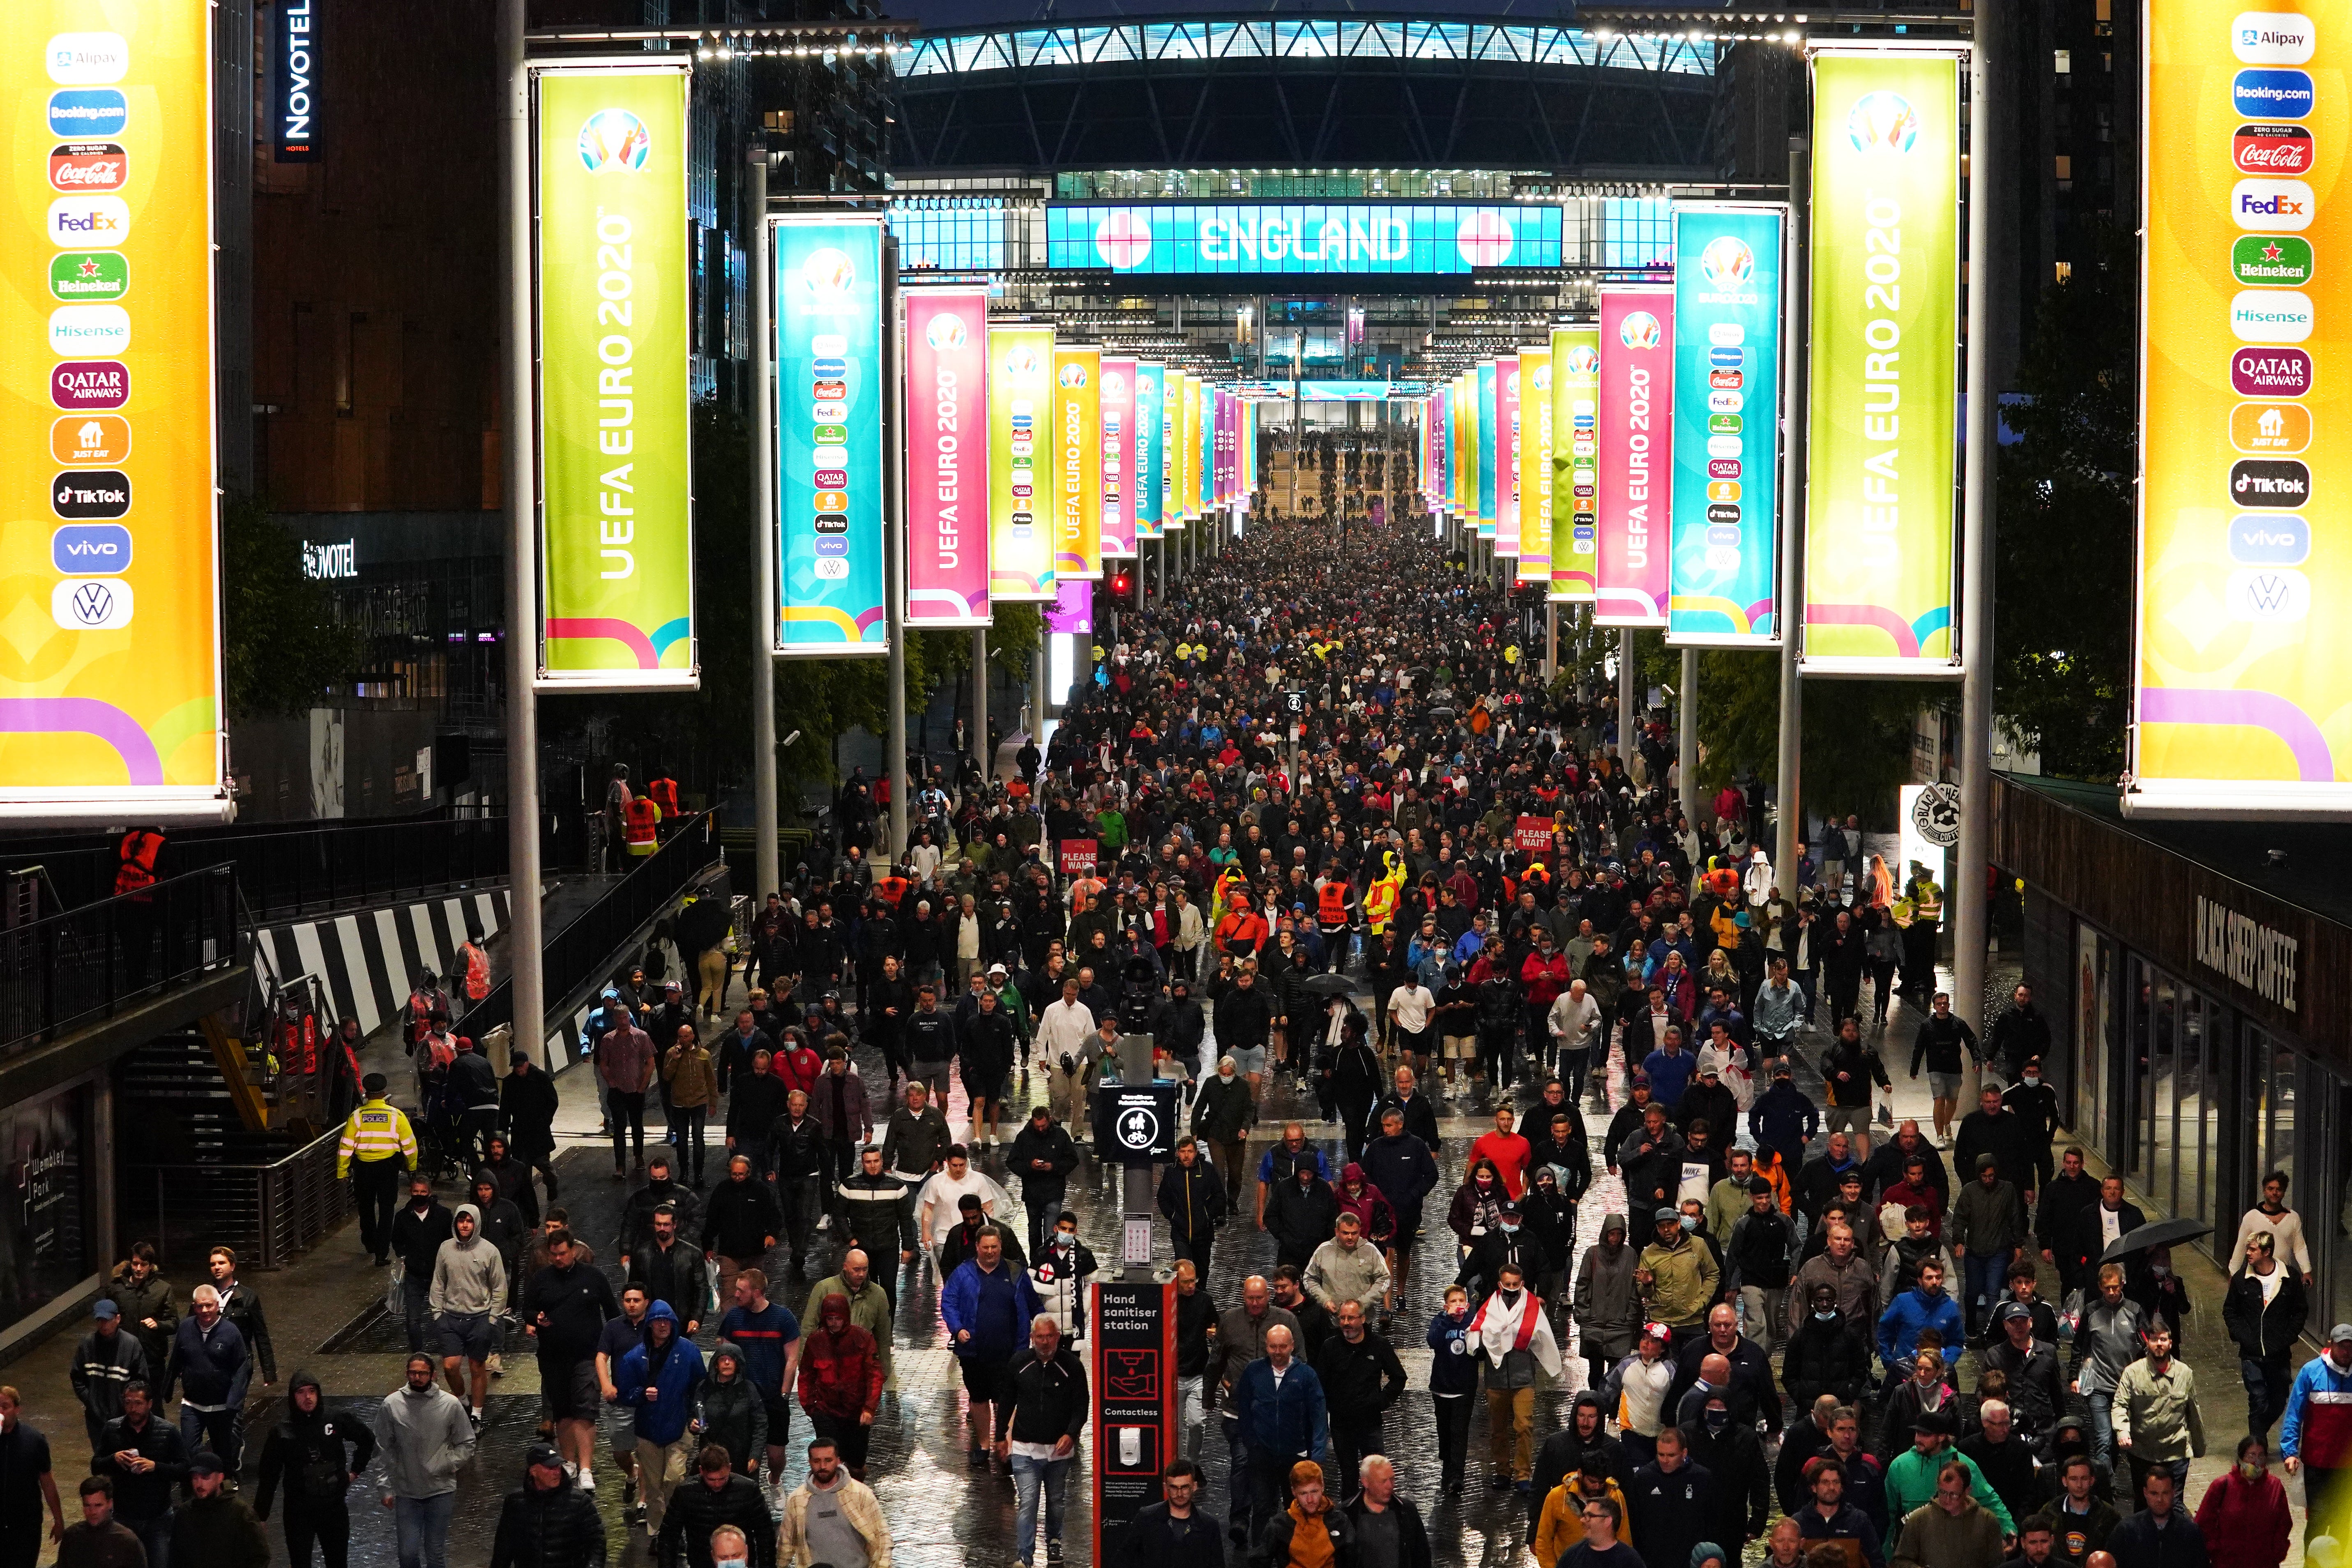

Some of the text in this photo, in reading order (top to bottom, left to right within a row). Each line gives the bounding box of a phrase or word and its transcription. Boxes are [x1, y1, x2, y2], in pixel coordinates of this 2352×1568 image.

[2261, 31, 2304, 46] Alipay
[76, 52, 117, 66] Alipay
[286, 0, 310, 138] NOVOTEL
[2236, 85, 2310, 101] Booking.com
[51, 106, 124, 120] Booking.com
[2240, 144, 2306, 167] Coca-Cola
[55, 161, 120, 185] Coca-Cola
[2242, 195, 2303, 215] FedEx
[59, 212, 118, 231] FedEx
[1200, 218, 1408, 261] ENGLAND
[2241, 263, 2304, 277] Heineken
[58, 279, 120, 292] Heineken
[2237, 310, 2307, 322] Hisense
[56, 325, 124, 337] Hisense
[2239, 358, 2303, 377] QATAR
[58, 372, 122, 391] QATAR
[1865, 318, 1900, 441] EURO
[2253, 375, 2304, 386] AIRWAYS
[73, 388, 122, 398] AIRWAYS
[598, 334, 633, 455] EURO
[2252, 438, 2289, 447] JUST EAT
[73, 450, 93, 458] JUST
[1137, 438, 1148, 473] EURO
[938, 435, 958, 502] EURO
[1067, 447, 1080, 493] EURO
[1628, 434, 1649, 501] EURO
[1711, 463, 1738, 471] QATAR
[1136, 474, 1147, 508] UEFA
[2252, 478, 2304, 493] TikTok
[74, 490, 125, 503] TikTok
[1864, 448, 1899, 568] UEFA
[599, 462, 635, 580] UEFA
[1067, 495, 1080, 539] UEFA
[938, 504, 958, 569] UEFA
[1627, 504, 1648, 569] UEFA
[2243, 529, 2295, 546] vivo
[66, 540, 118, 555] vivo
[1917, 794, 1937, 817] BLAC
[1517, 829, 1551, 839] PLEASE
[1522, 838, 1546, 847] WAIT
[1062, 852, 1096, 861] PLEASE
[2196, 895, 2298, 1014] BLACK SHEEP COFFEE
[32, 1149, 65, 1176] Wembley
[1683, 1167, 1701, 1175] NIKE
[33, 1177, 51, 1199] Park
[1104, 1294, 1136, 1304] Hand
[1104, 1307, 1157, 1317] sanitiser
[1104, 1320, 1149, 1330] station
[1105, 1408, 1158, 1416] Contactless
